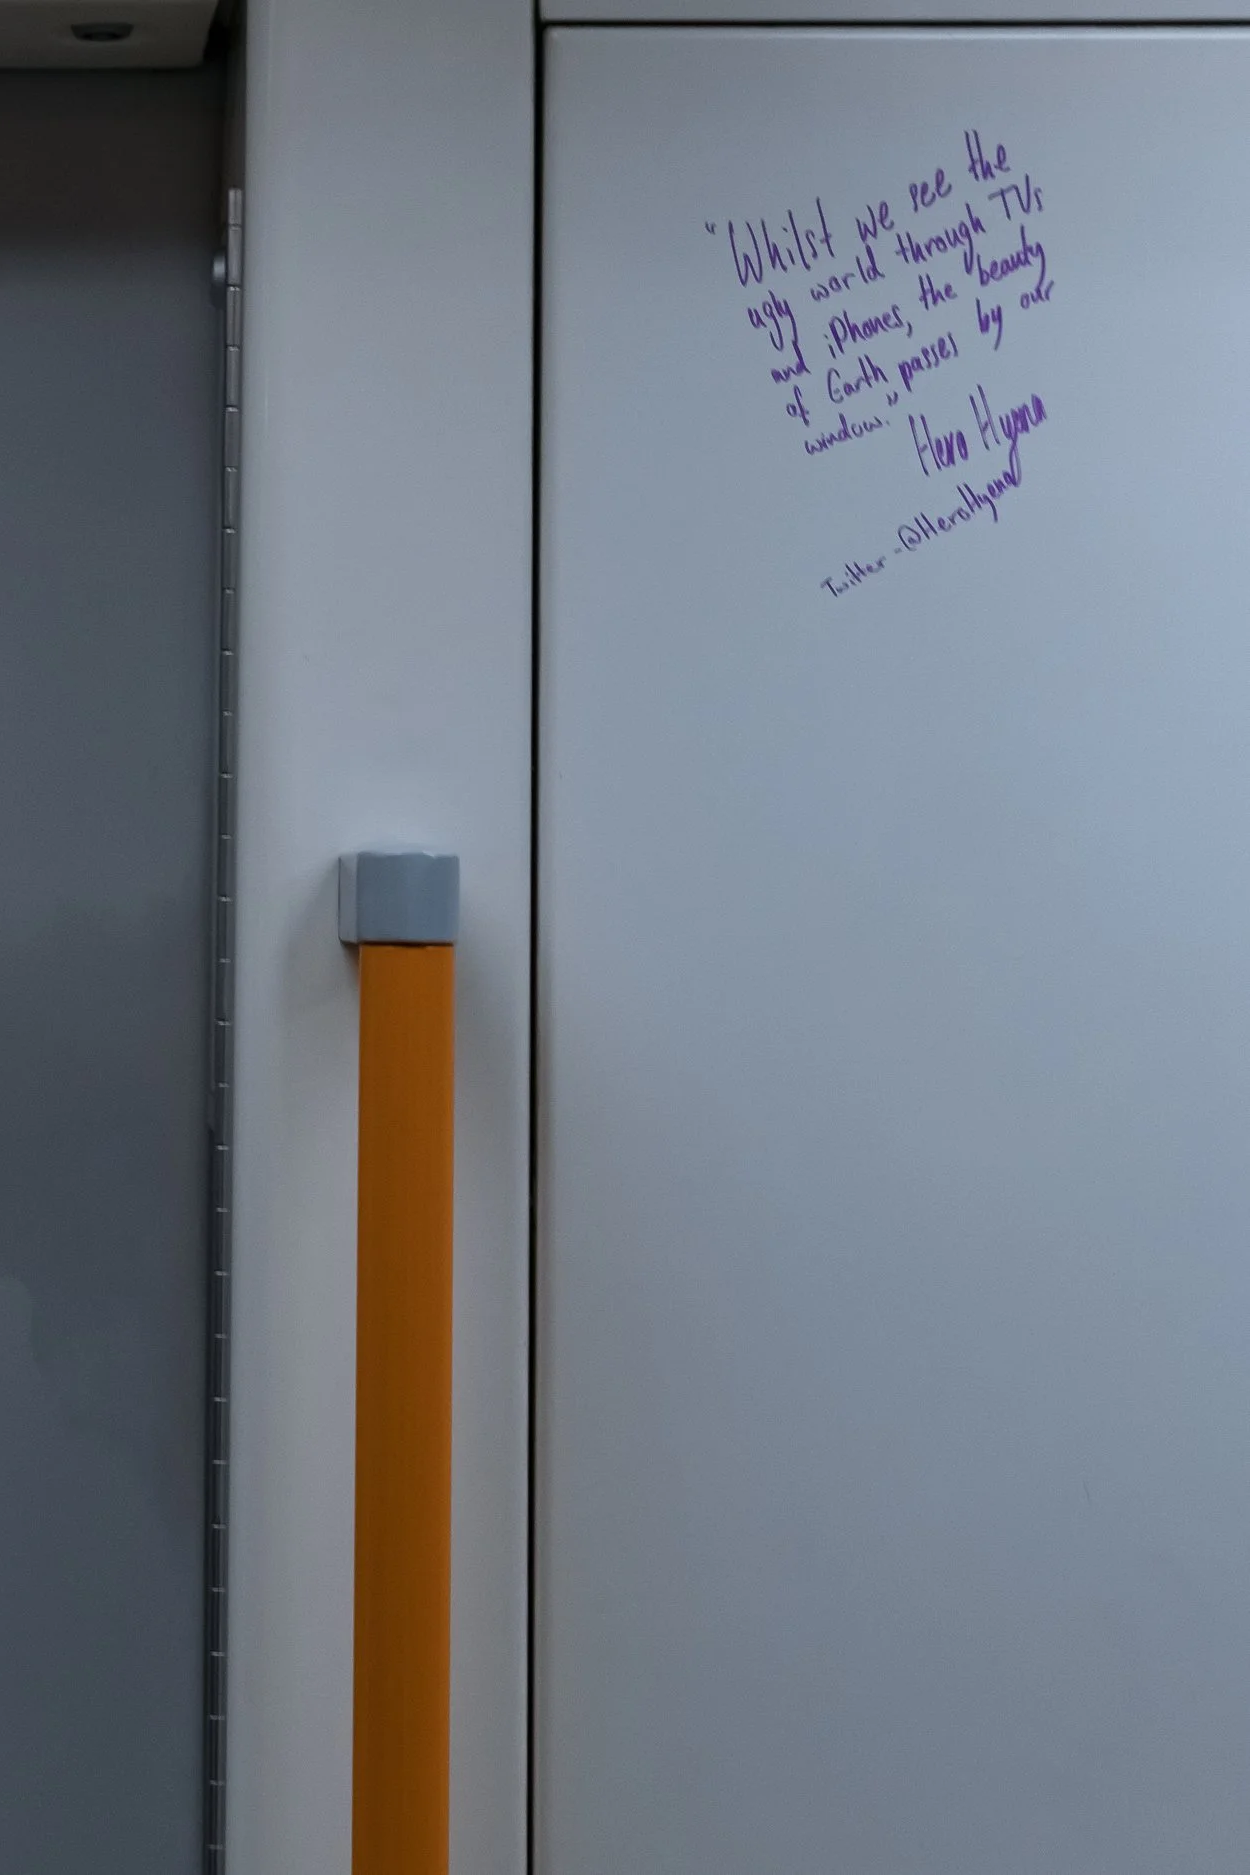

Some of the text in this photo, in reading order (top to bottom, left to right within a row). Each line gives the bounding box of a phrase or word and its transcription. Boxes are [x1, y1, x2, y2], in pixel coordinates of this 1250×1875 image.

[855, 201, 894, 242] we
[909, 168, 952, 212] see
[964, 129, 1010, 181] the
[748, 174, 1044, 351] ugly world through TVs
[771, 340, 811, 382] and
[919, 273, 958, 311] the
[976, 224, 1046, 289] beauty
[786, 385, 809, 427] of
[976, 298, 1002, 351] by
[1020, 281, 1054, 309] our
[908, 414, 969, 477] Hero
[820, 556, 886, 598] Twitter
